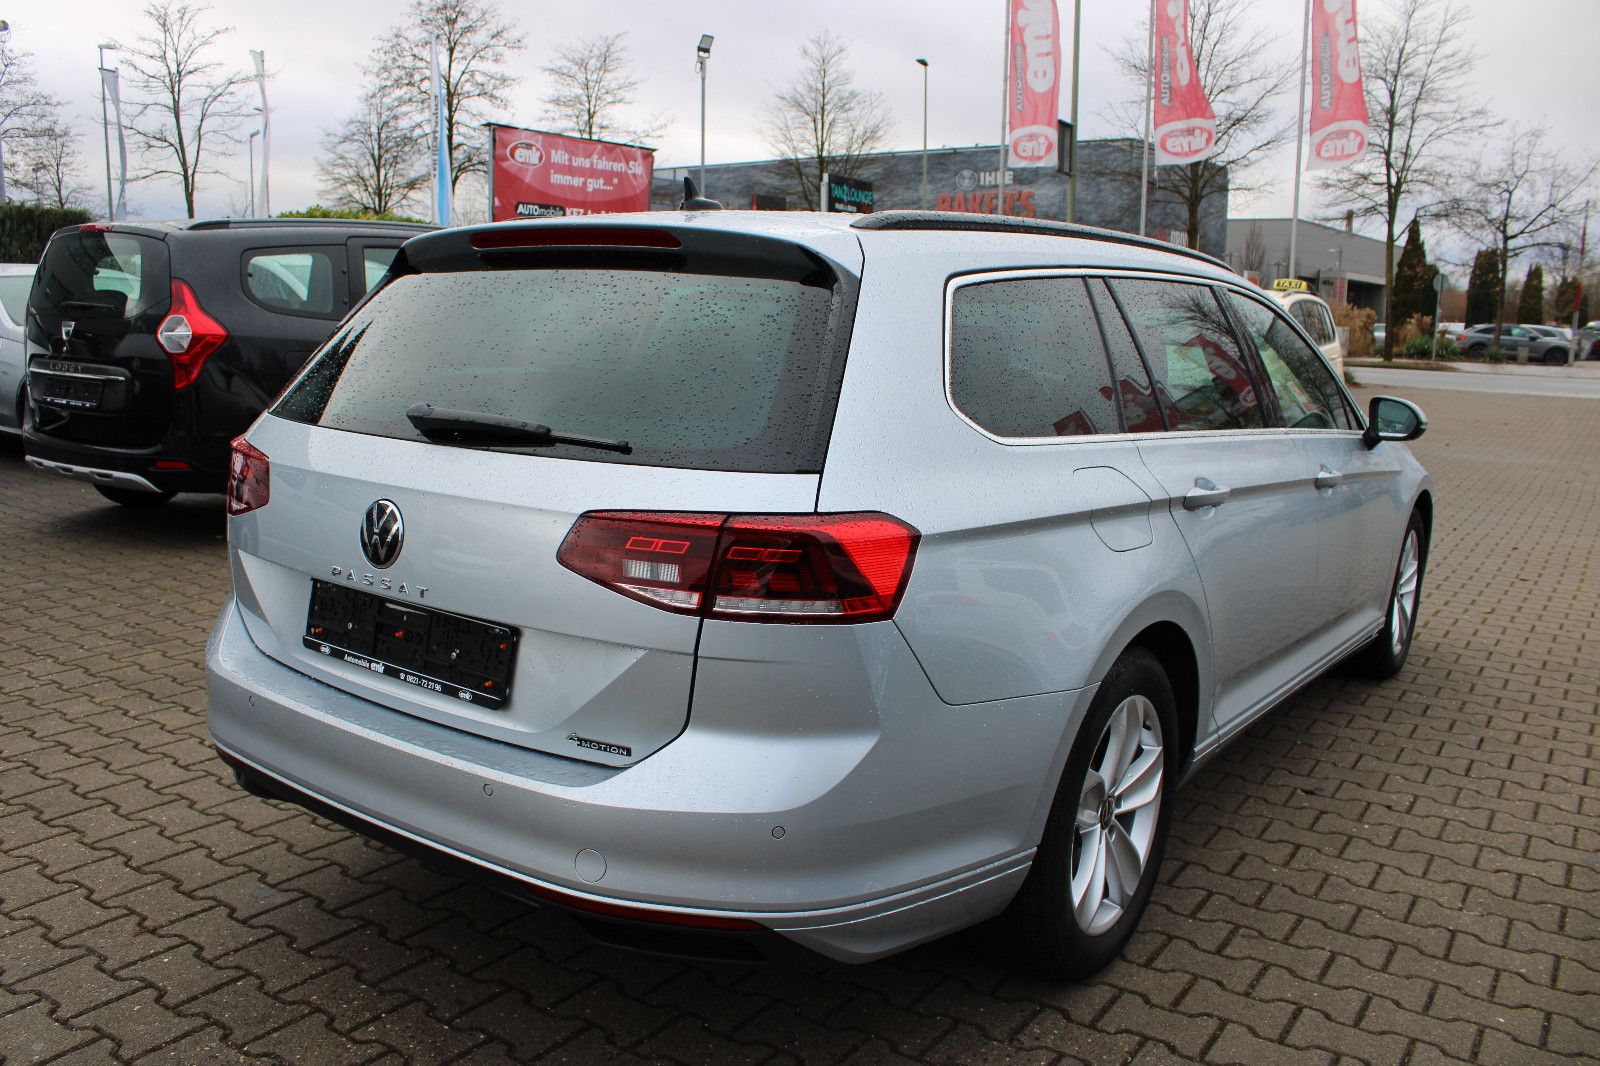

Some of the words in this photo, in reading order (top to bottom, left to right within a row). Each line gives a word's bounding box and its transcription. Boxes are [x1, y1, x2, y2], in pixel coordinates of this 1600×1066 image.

[550, 149, 570, 164] Mit
[572, 155, 591, 168] uns
[593, 155, 625, 173] fahren
[628, 160, 644, 176] Sie
[550, 170, 584, 187] immer
[1276, 280, 1302, 289] TAXI
[331, 565, 429, 598] PASSAT
[343, 653, 370, 669] Automobile
